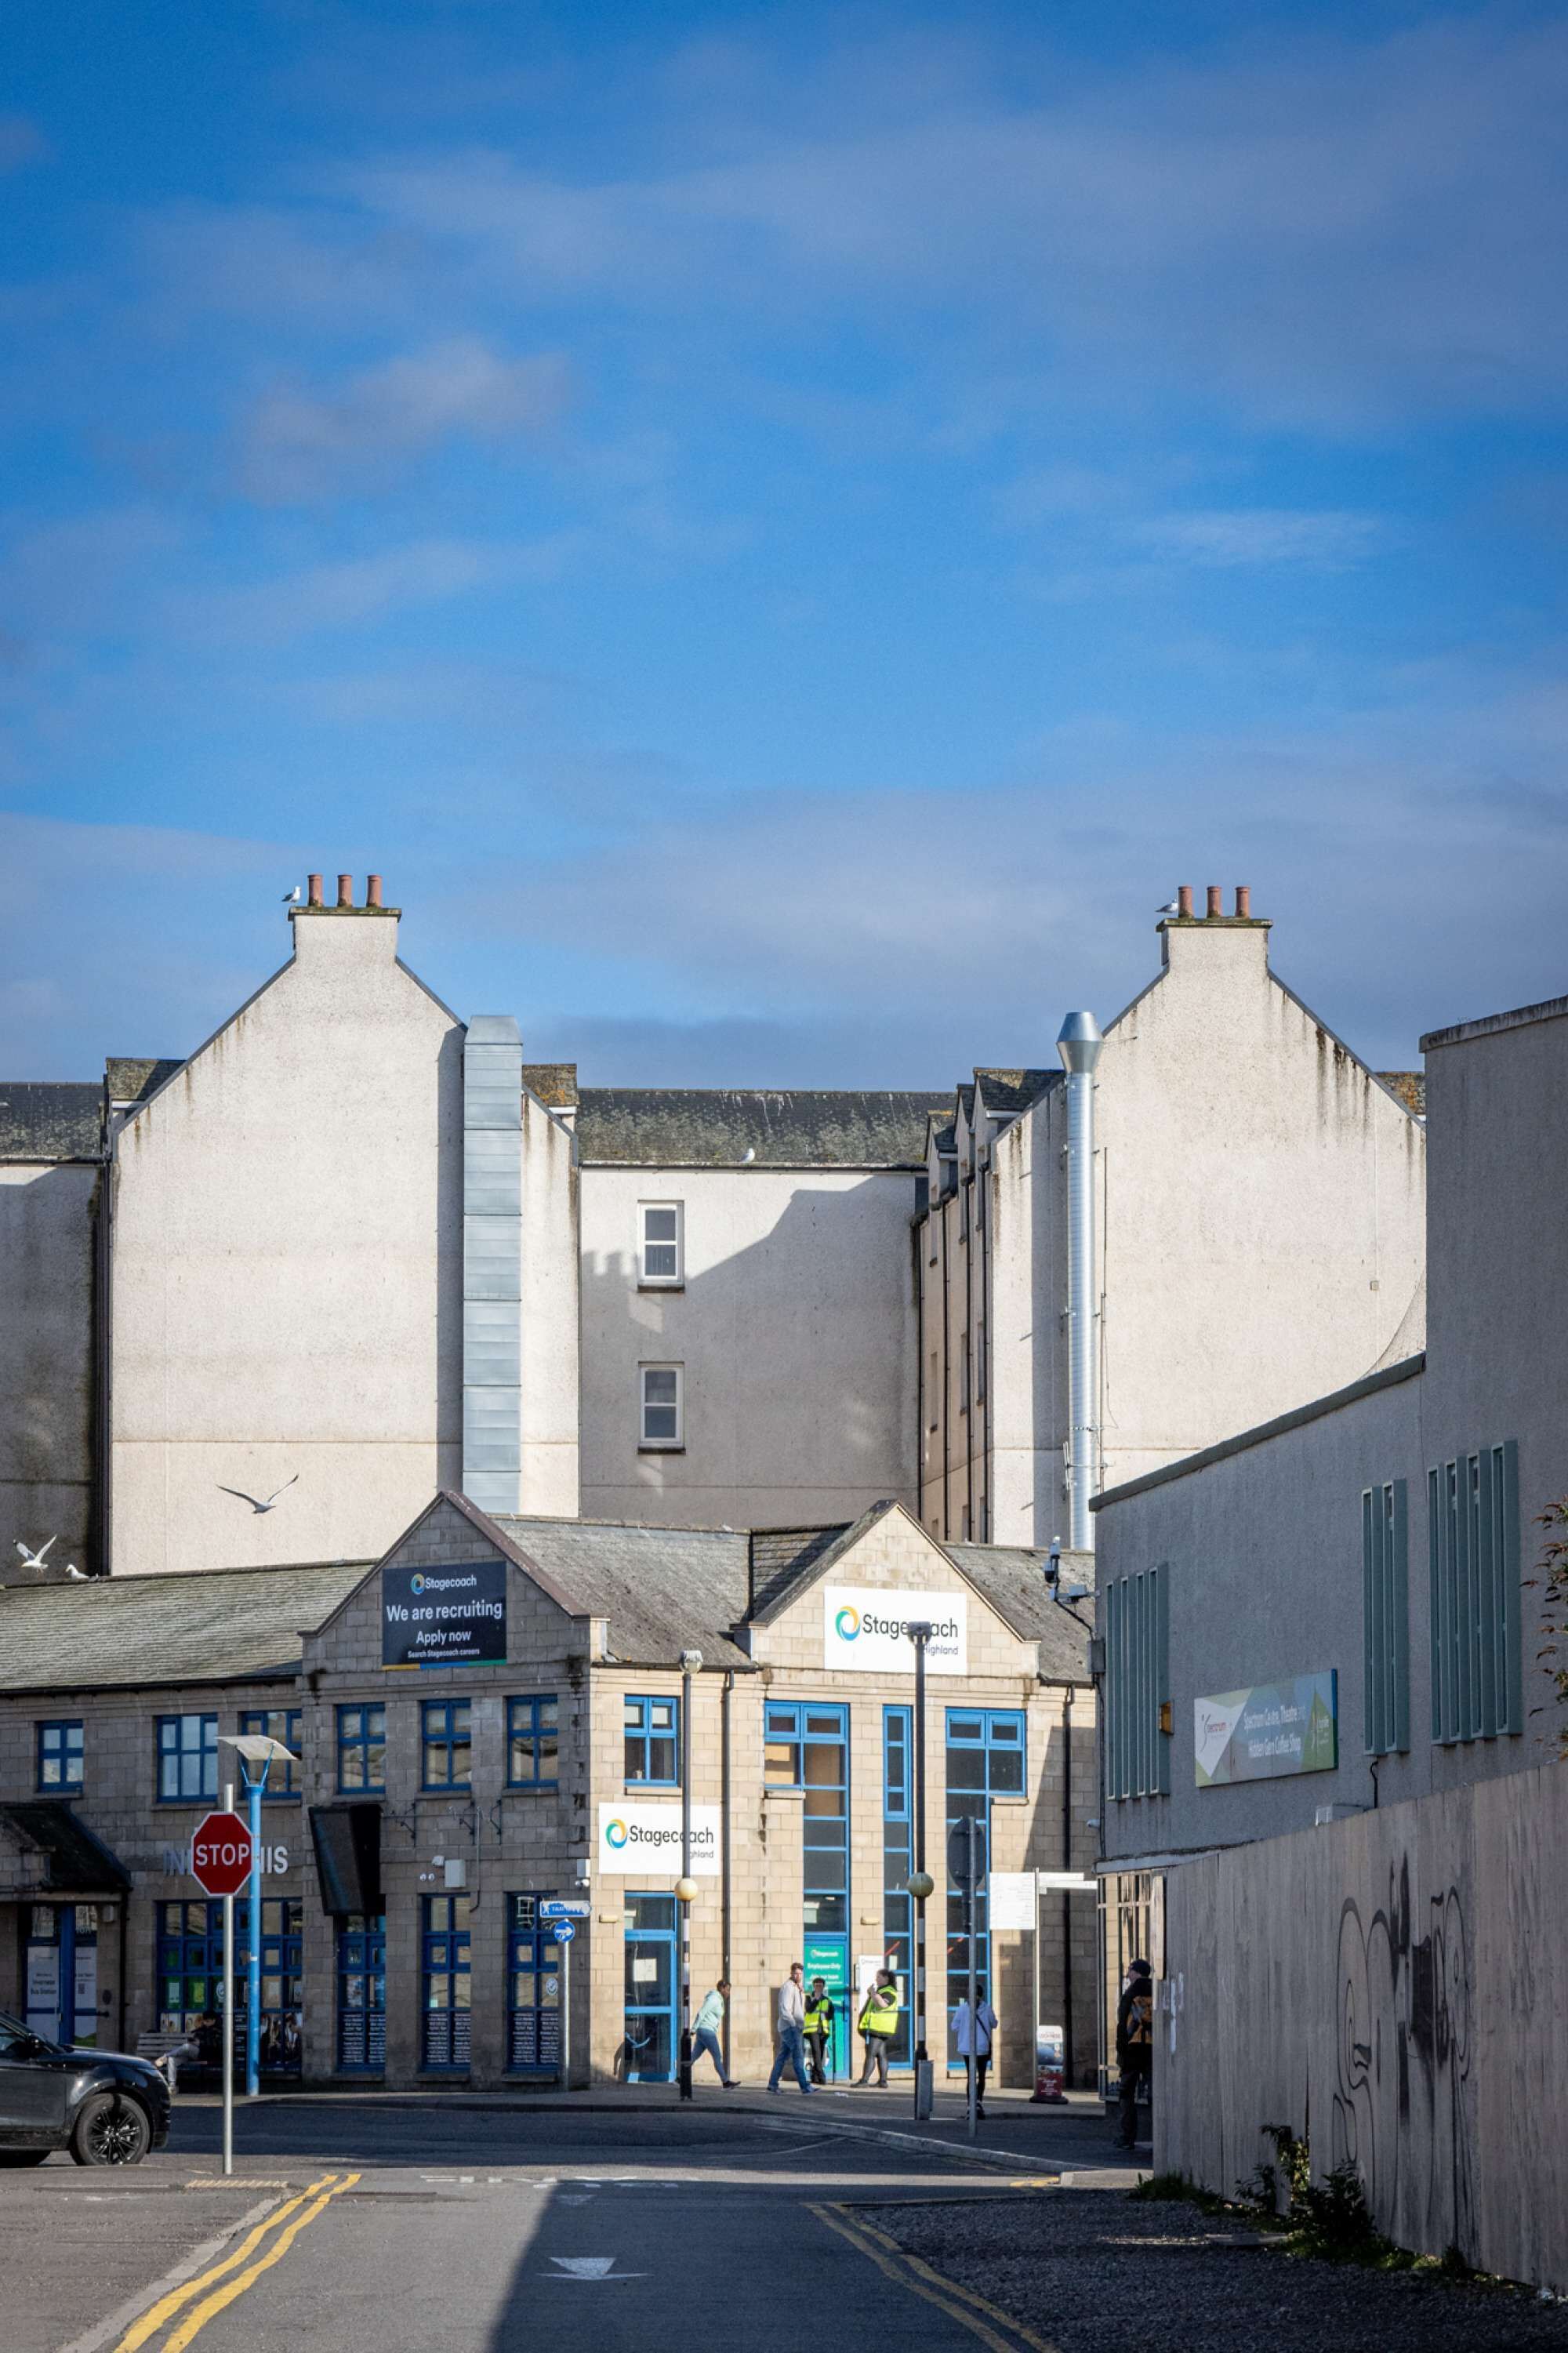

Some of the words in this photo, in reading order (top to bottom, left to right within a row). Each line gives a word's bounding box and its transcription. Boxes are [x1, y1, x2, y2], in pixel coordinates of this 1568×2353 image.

[426, 1574, 477, 1590] Stagecoach
[387, 1604, 408, 1622] We
[412, 1608, 433, 1621] are
[436, 1600, 503, 1620] recruiting
[862, 1614, 958, 1639] Stageach
[416, 1629, 447, 1646] Apply
[448, 1631, 471, 1642] now
[408, 1650, 427, 1658] Search
[427, 1649, 459, 1658] Stagecoach
[196, 1843, 249, 1866] STOP
